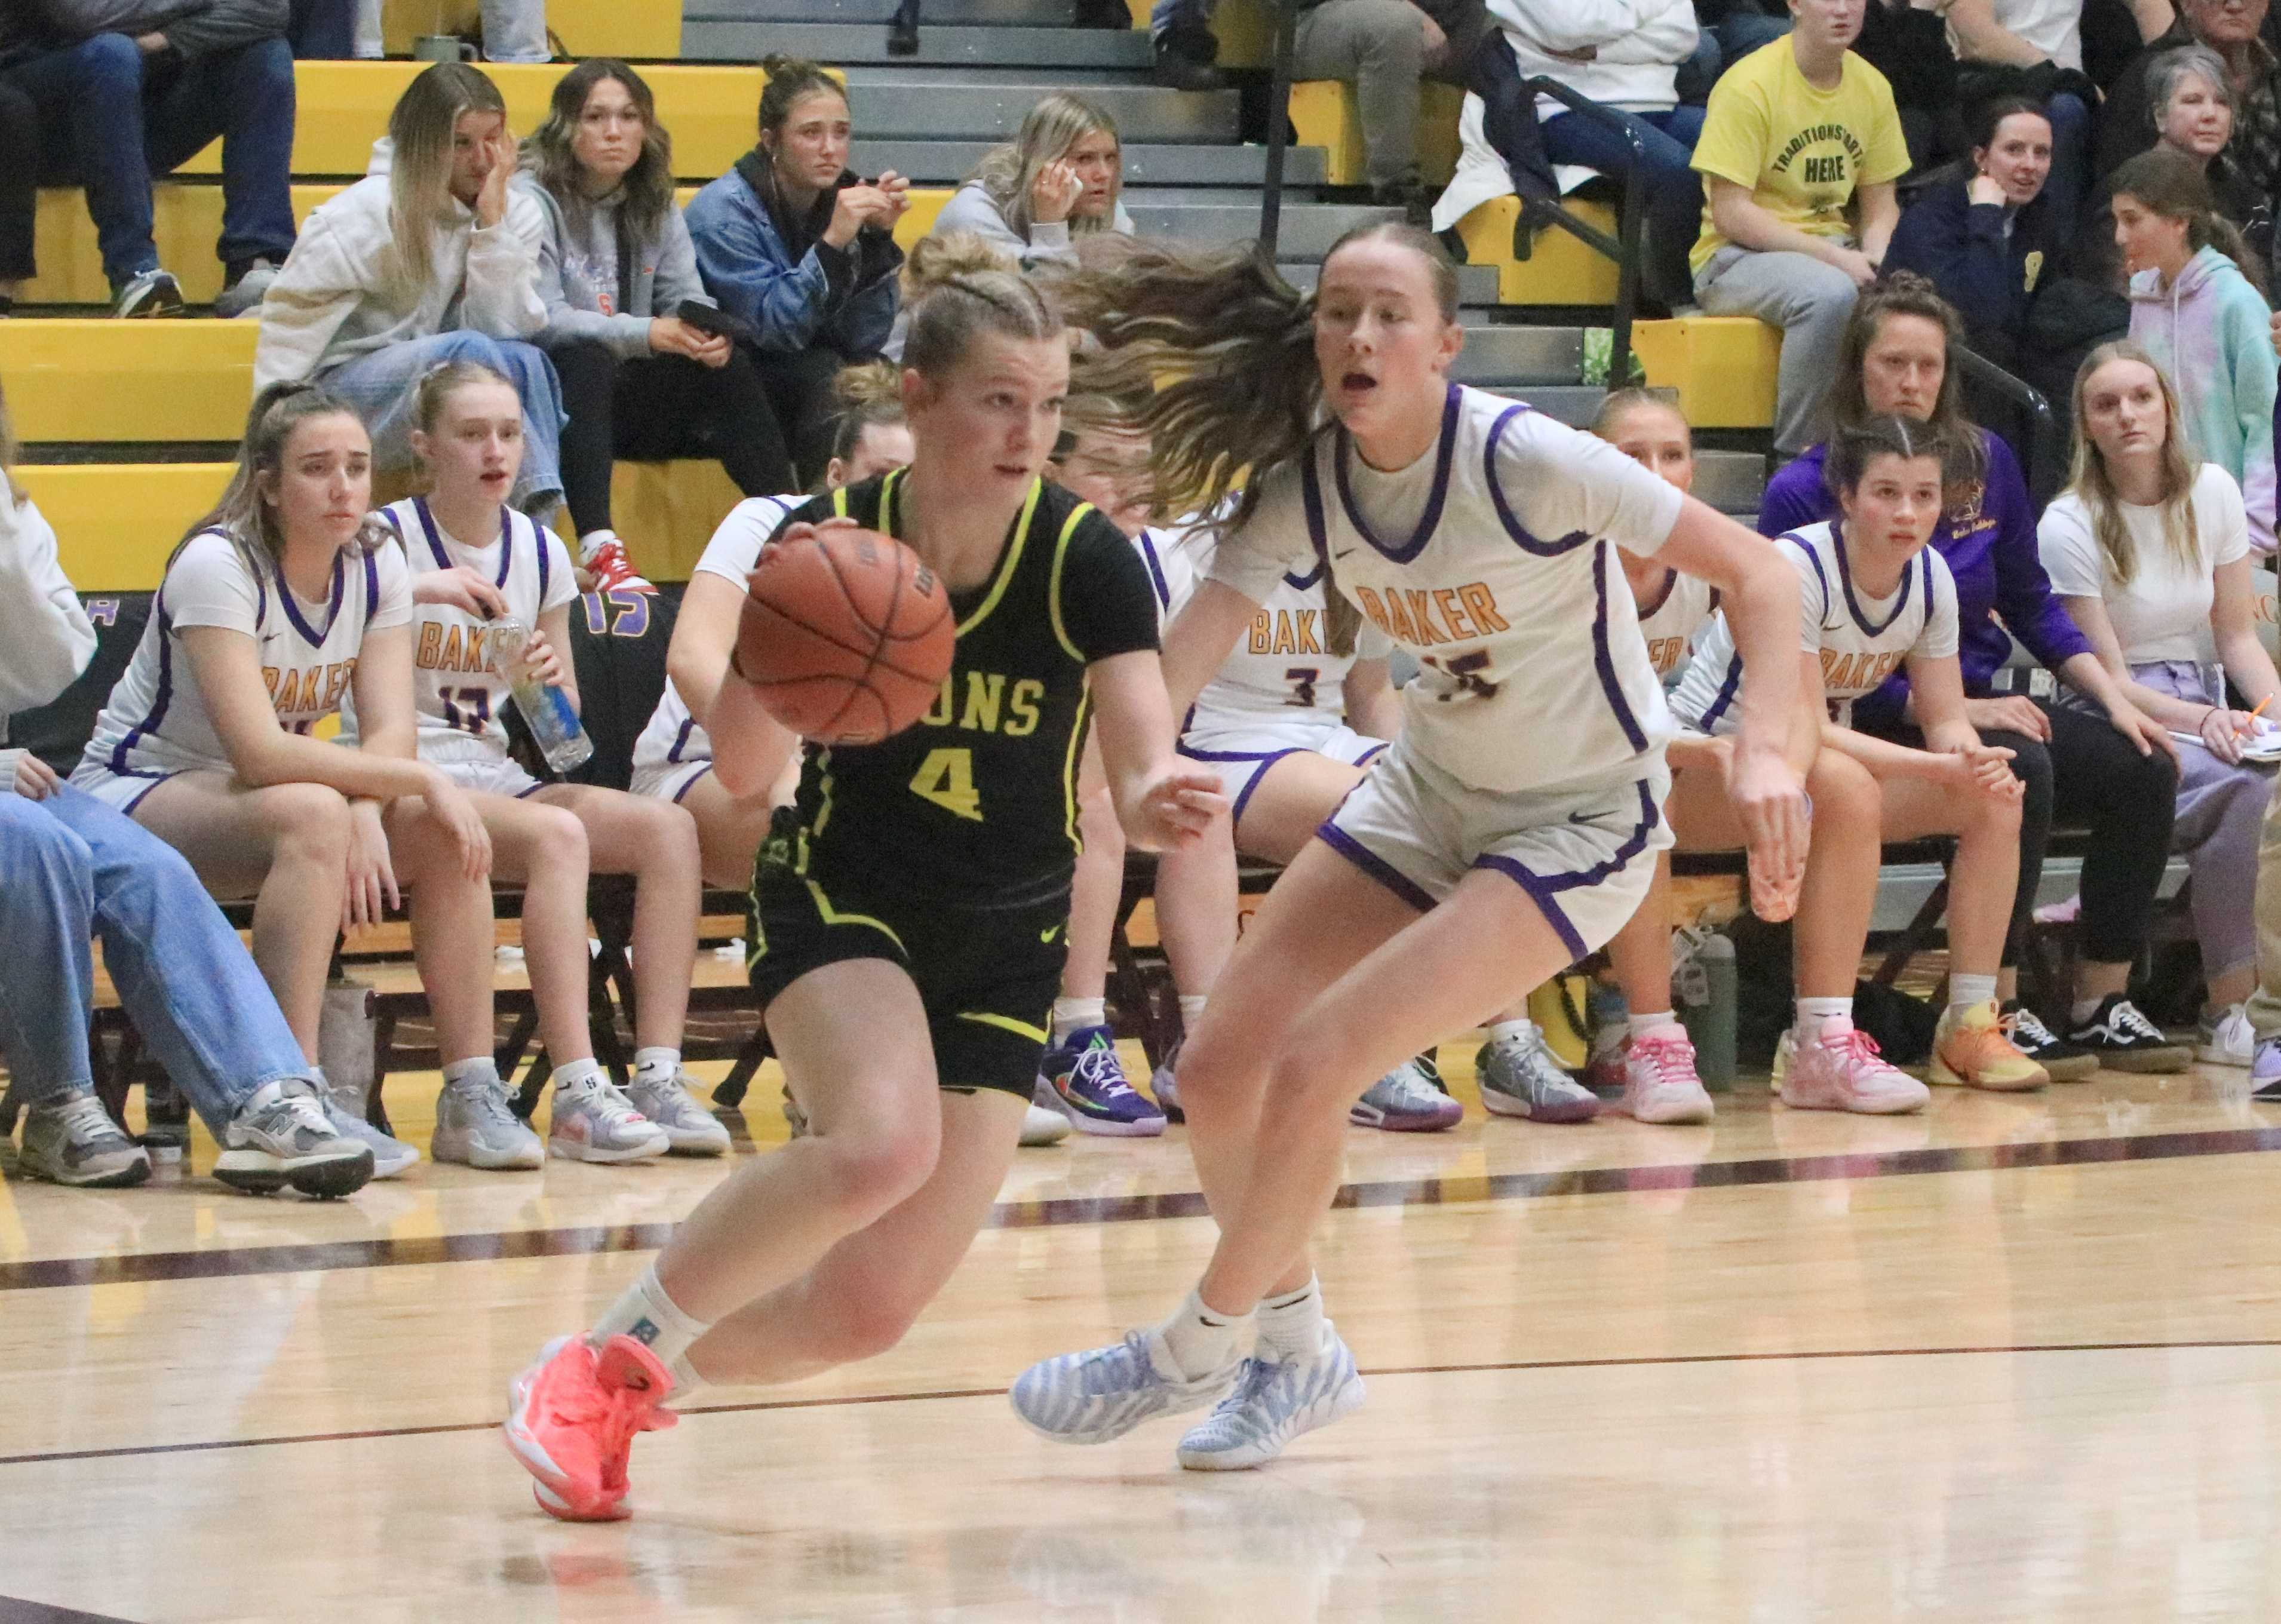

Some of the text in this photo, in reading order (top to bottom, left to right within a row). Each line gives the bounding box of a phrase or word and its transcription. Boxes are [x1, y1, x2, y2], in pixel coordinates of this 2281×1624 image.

[1804, 155, 1845, 183] HERE
[1355, 582, 1511, 646] BAKER
[920, 670, 1045, 736] ONS
[1284, 668, 1320, 707] 3
[908, 747, 984, 822] 4
